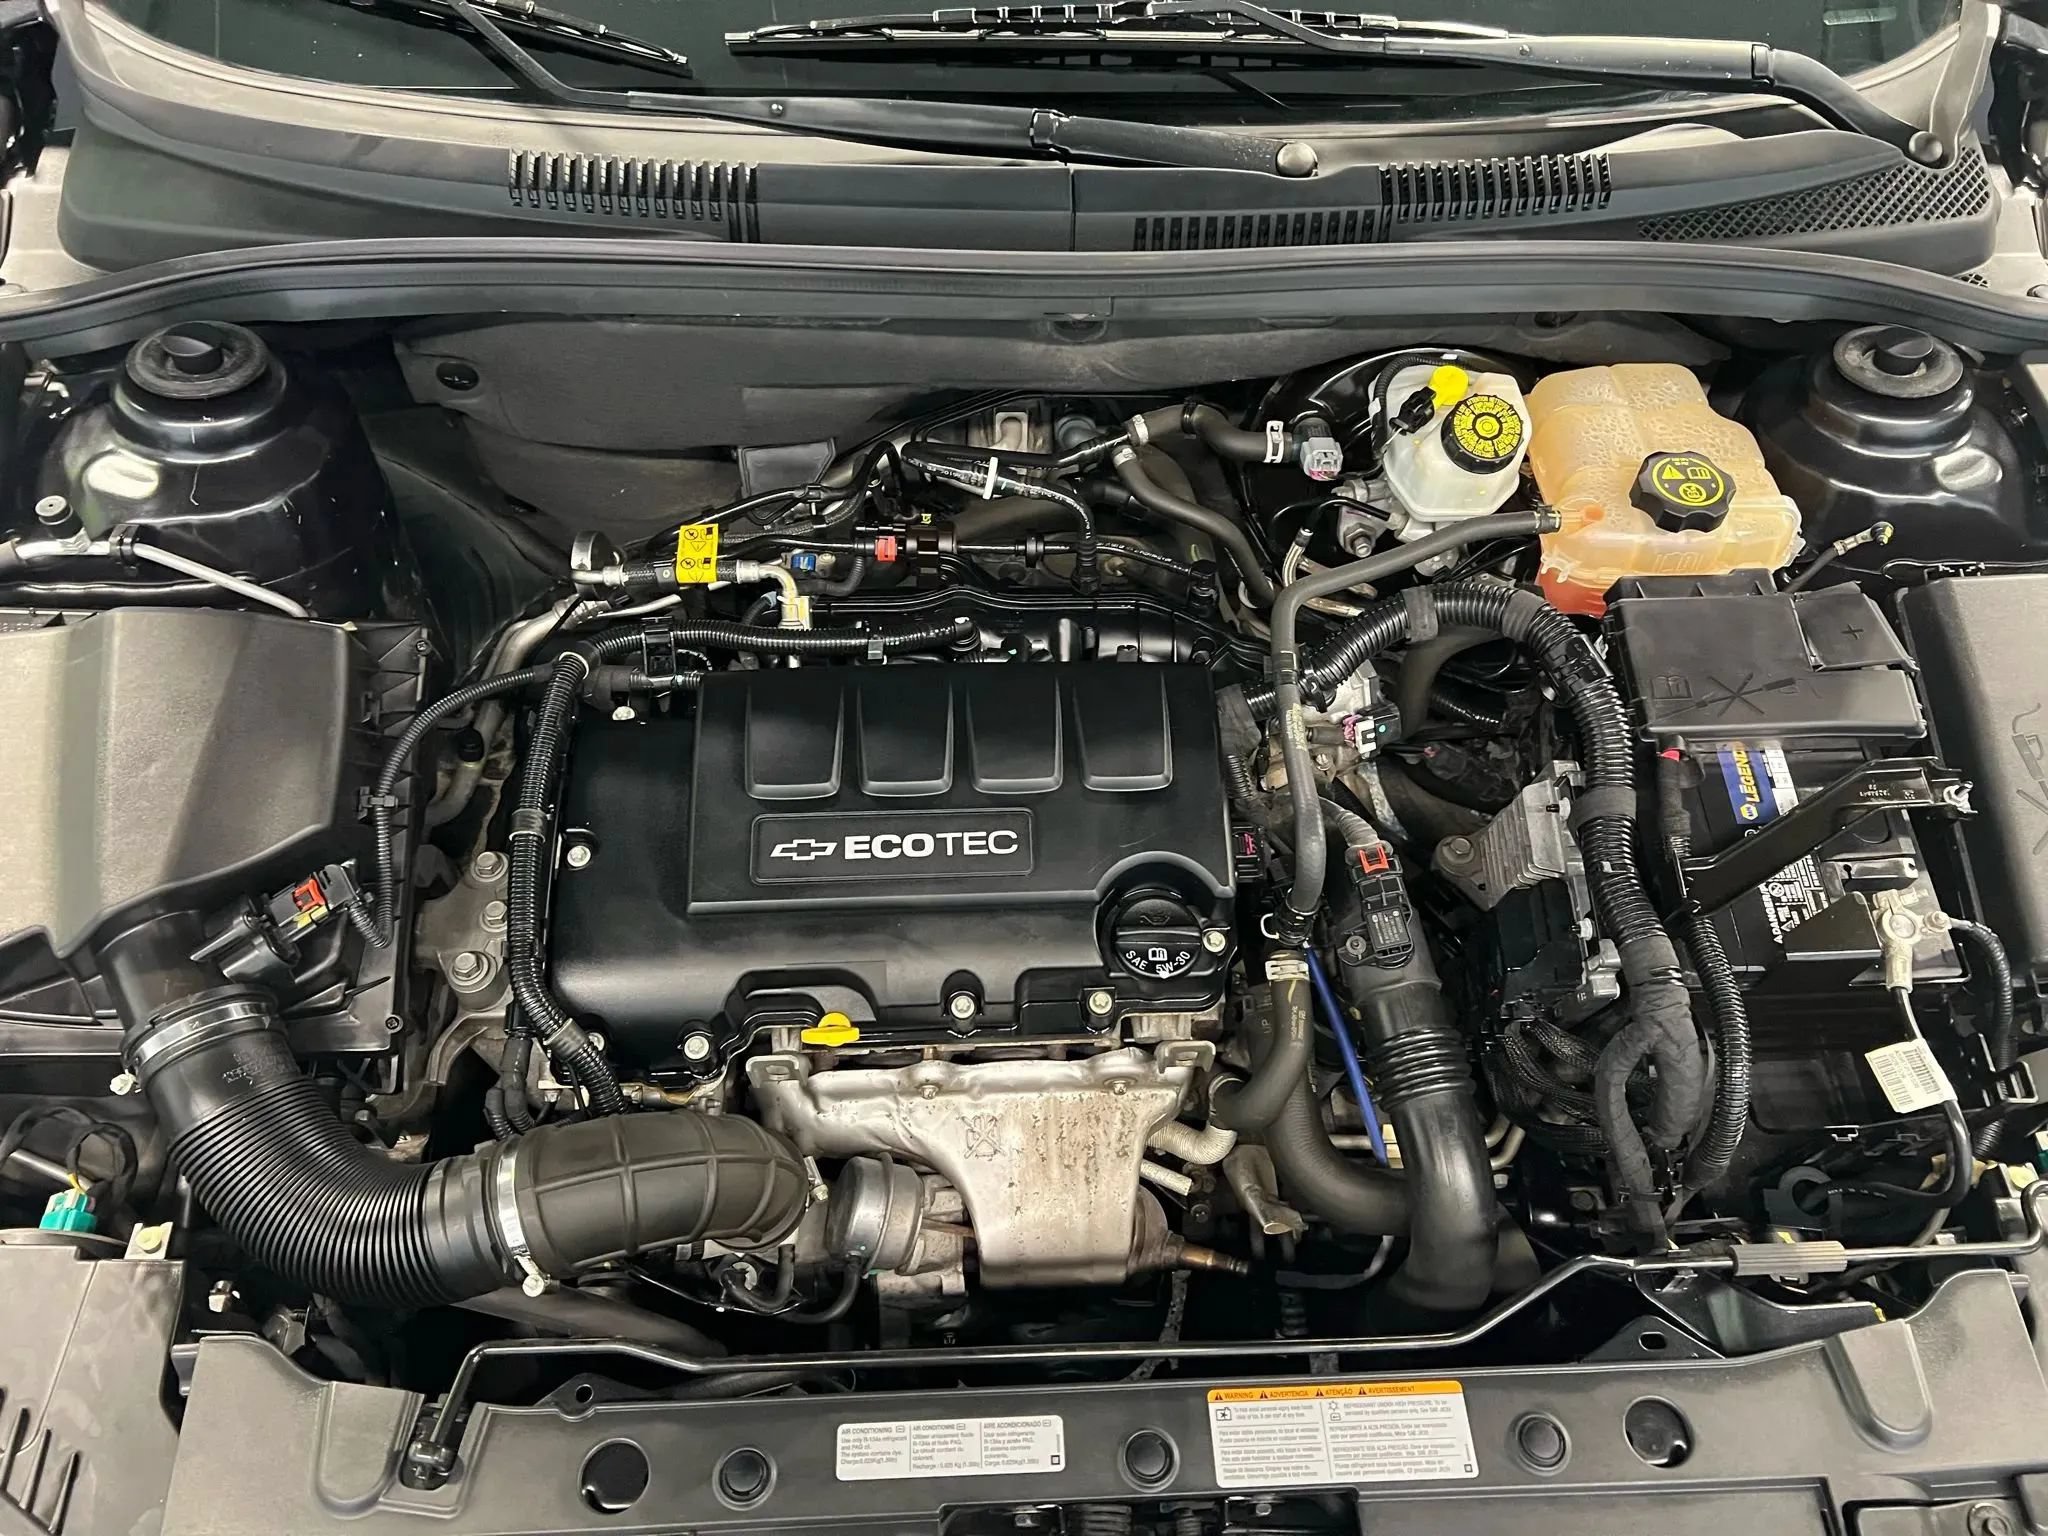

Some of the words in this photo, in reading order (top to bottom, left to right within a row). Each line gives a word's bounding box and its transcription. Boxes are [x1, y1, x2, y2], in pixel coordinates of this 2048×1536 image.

[843, 829, 1019, 860] ECOTEC
[1125, 950, 1149, 970] SAE
[1155, 951, 1191, 974] 5W-30
[1325, 1387, 1353, 1397] ATENÇÃO
[1368, 1385, 1415, 1394] AVERTISSEMENT
[1224, 1391, 1254, 1399] WARNING
[852, 1426, 892, 1434] CONDITIONING
